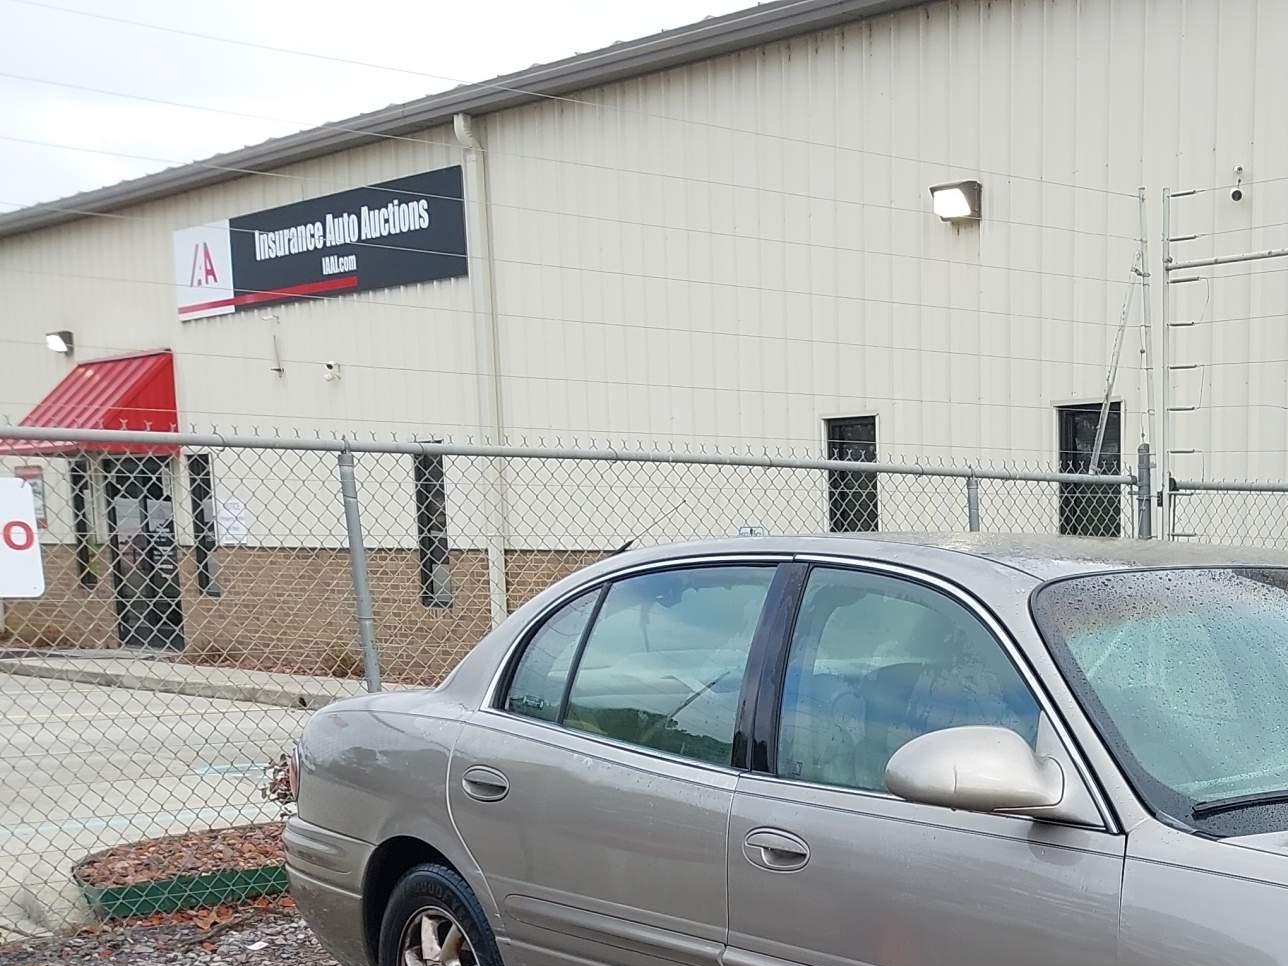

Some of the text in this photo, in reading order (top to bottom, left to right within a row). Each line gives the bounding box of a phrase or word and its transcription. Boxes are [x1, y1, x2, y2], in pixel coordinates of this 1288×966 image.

[255, 199, 429, 261] Insurance Auto Auctions
[3, 520, 34, 551] O
